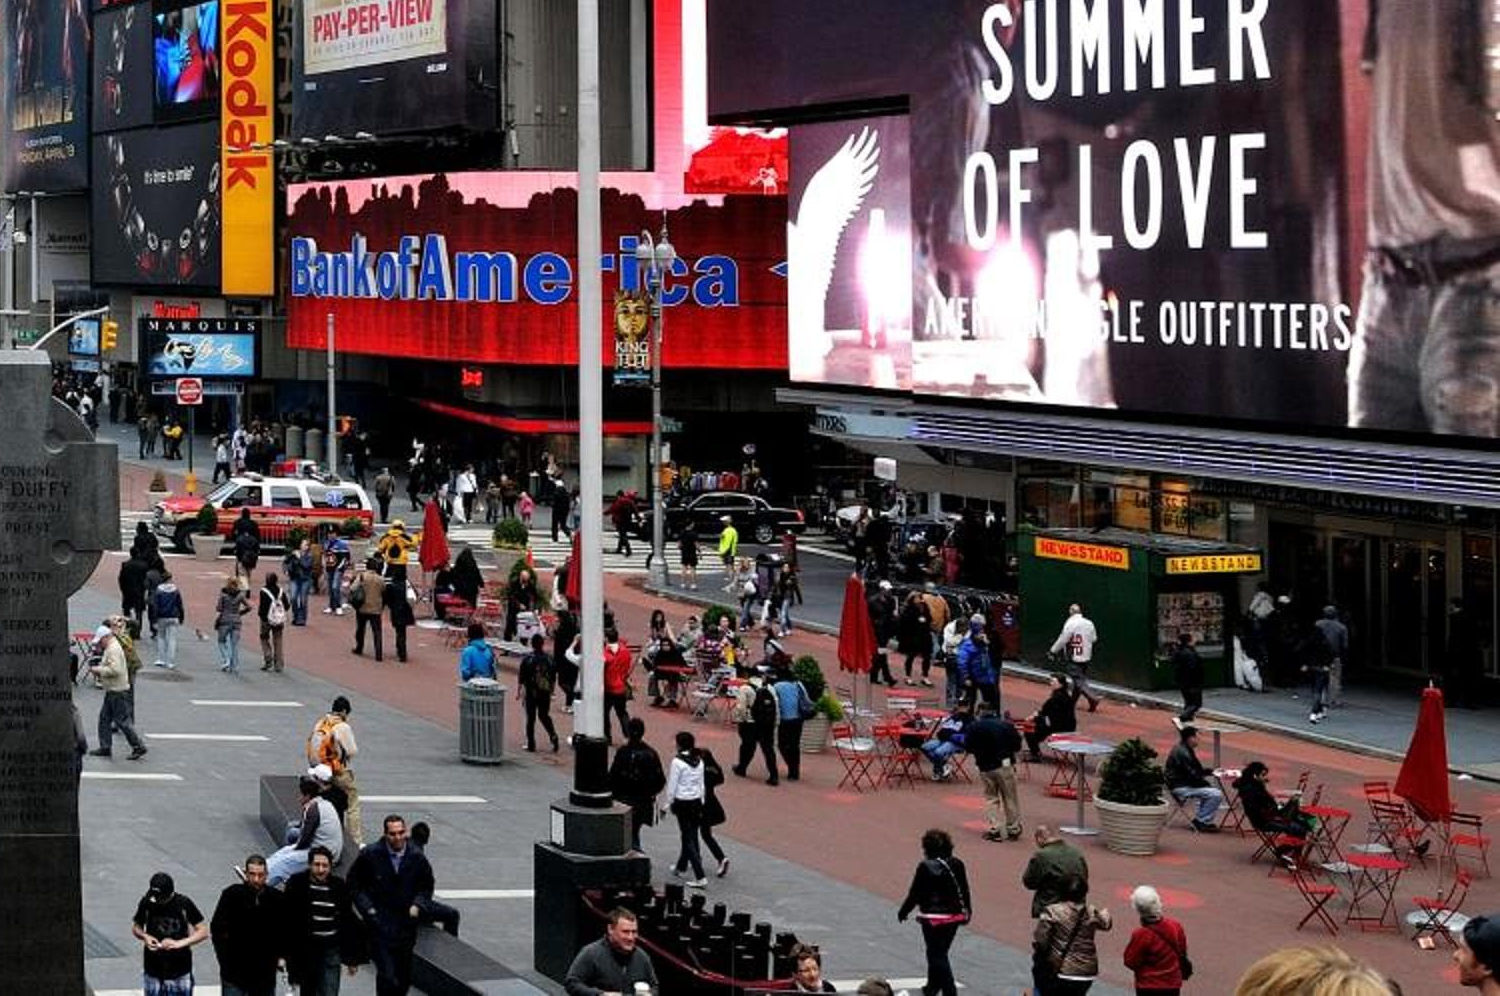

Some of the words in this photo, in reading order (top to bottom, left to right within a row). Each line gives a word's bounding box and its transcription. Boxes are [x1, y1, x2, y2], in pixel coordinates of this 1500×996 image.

[225, 1, 269, 191] Kodak
[963, 147, 1040, 251] OF
[1078, 132, 1270, 251] LOVE
[291, 232, 376, 299] Bank
[376, 234, 419, 300] of
[148, 320, 256, 332] MARQUIS
[1159, 301, 1353, 352] OUTFITTERS
[11, 480, 73, 497] DUFFY
[1040, 540, 1124, 564] NEWSSTAND
[1170, 556, 1256, 571] NEWSSTAND
